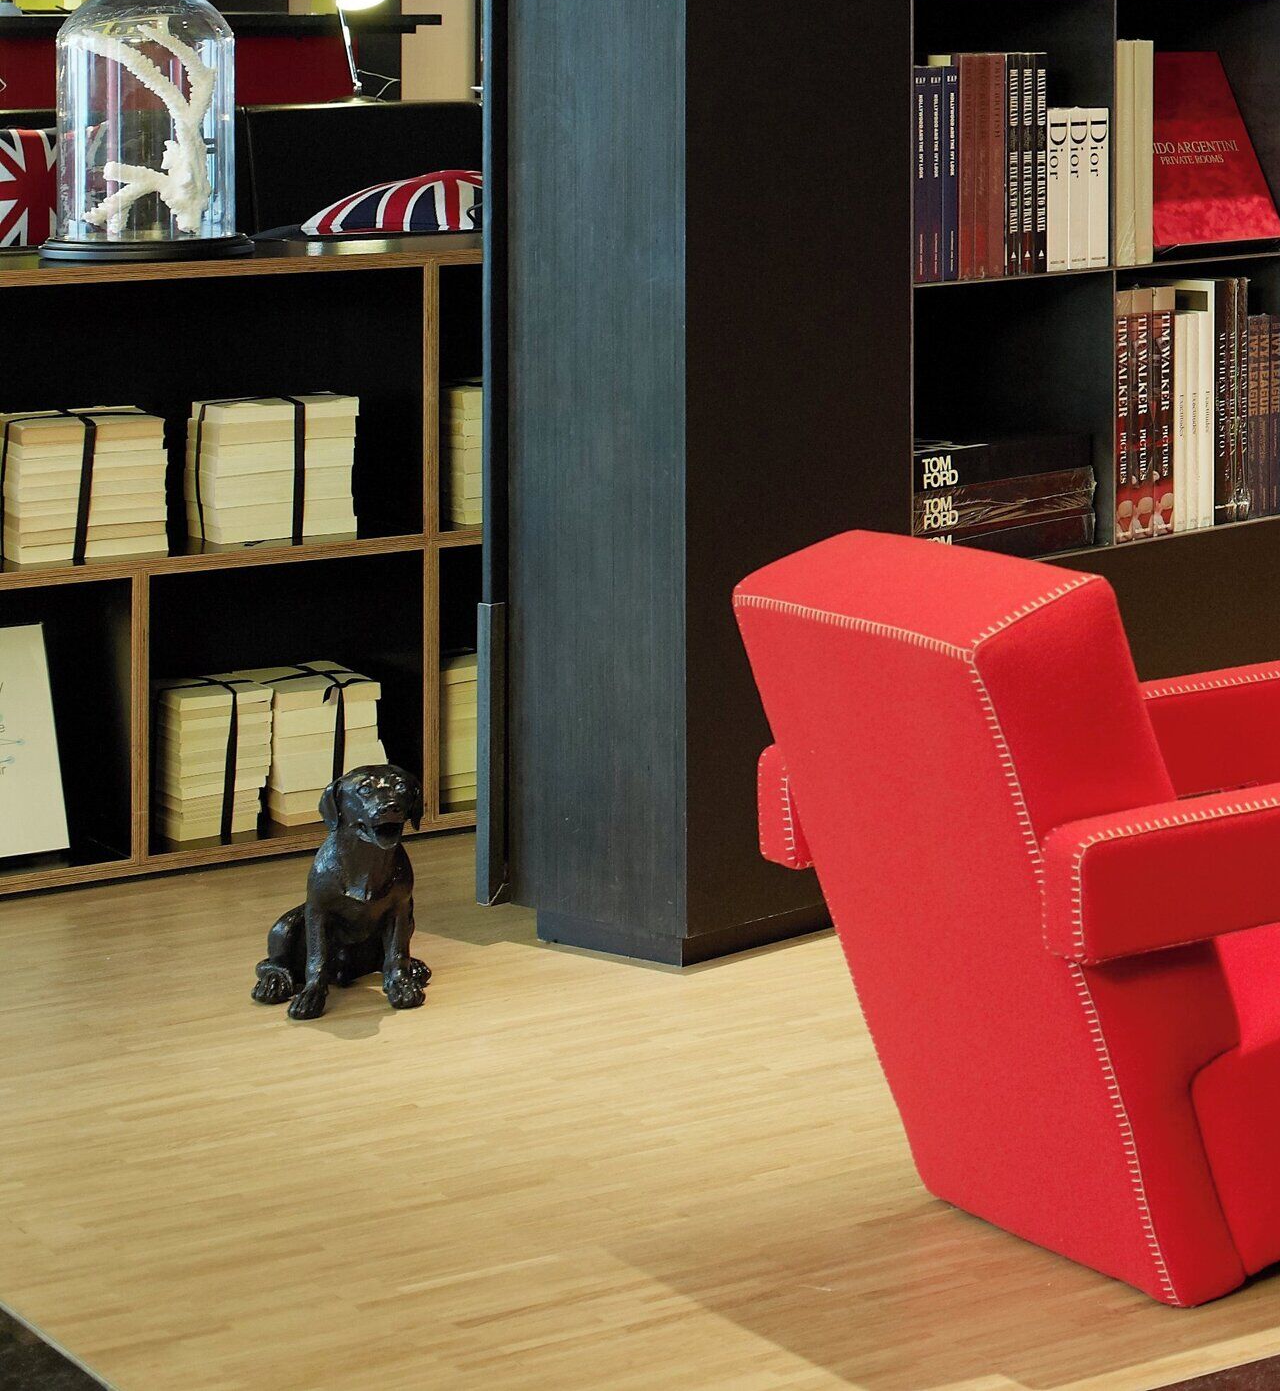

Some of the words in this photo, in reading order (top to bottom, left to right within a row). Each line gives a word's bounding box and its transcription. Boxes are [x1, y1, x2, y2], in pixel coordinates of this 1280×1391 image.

[1050, 117, 1067, 179] Dior
[1071, 115, 1088, 178] Dior
[1090, 114, 1107, 176] Dior
[1151, 143, 1174, 154] IDO
[1177, 140, 1239, 154] ARGENTINI
[1160, 155, 1194, 165] PRIVATE
[1195, 154, 1224, 164] ROOMS
[1117, 317, 1127, 347] TIM
[1138, 314, 1147, 345] TIM
[1161, 311, 1171, 341] TIM
[1118, 349, 1127, 418] WALKER
[1138, 347, 1147, 414] WALKER
[1161, 343, 1171, 411] WALKER
[922, 455, 952, 474] TOM
[1139, 429, 1147, 480] PICTURES
[923, 470, 958, 489] FORD
[923, 496, 952, 515] TOM
[924, 510, 958, 530] FORD
